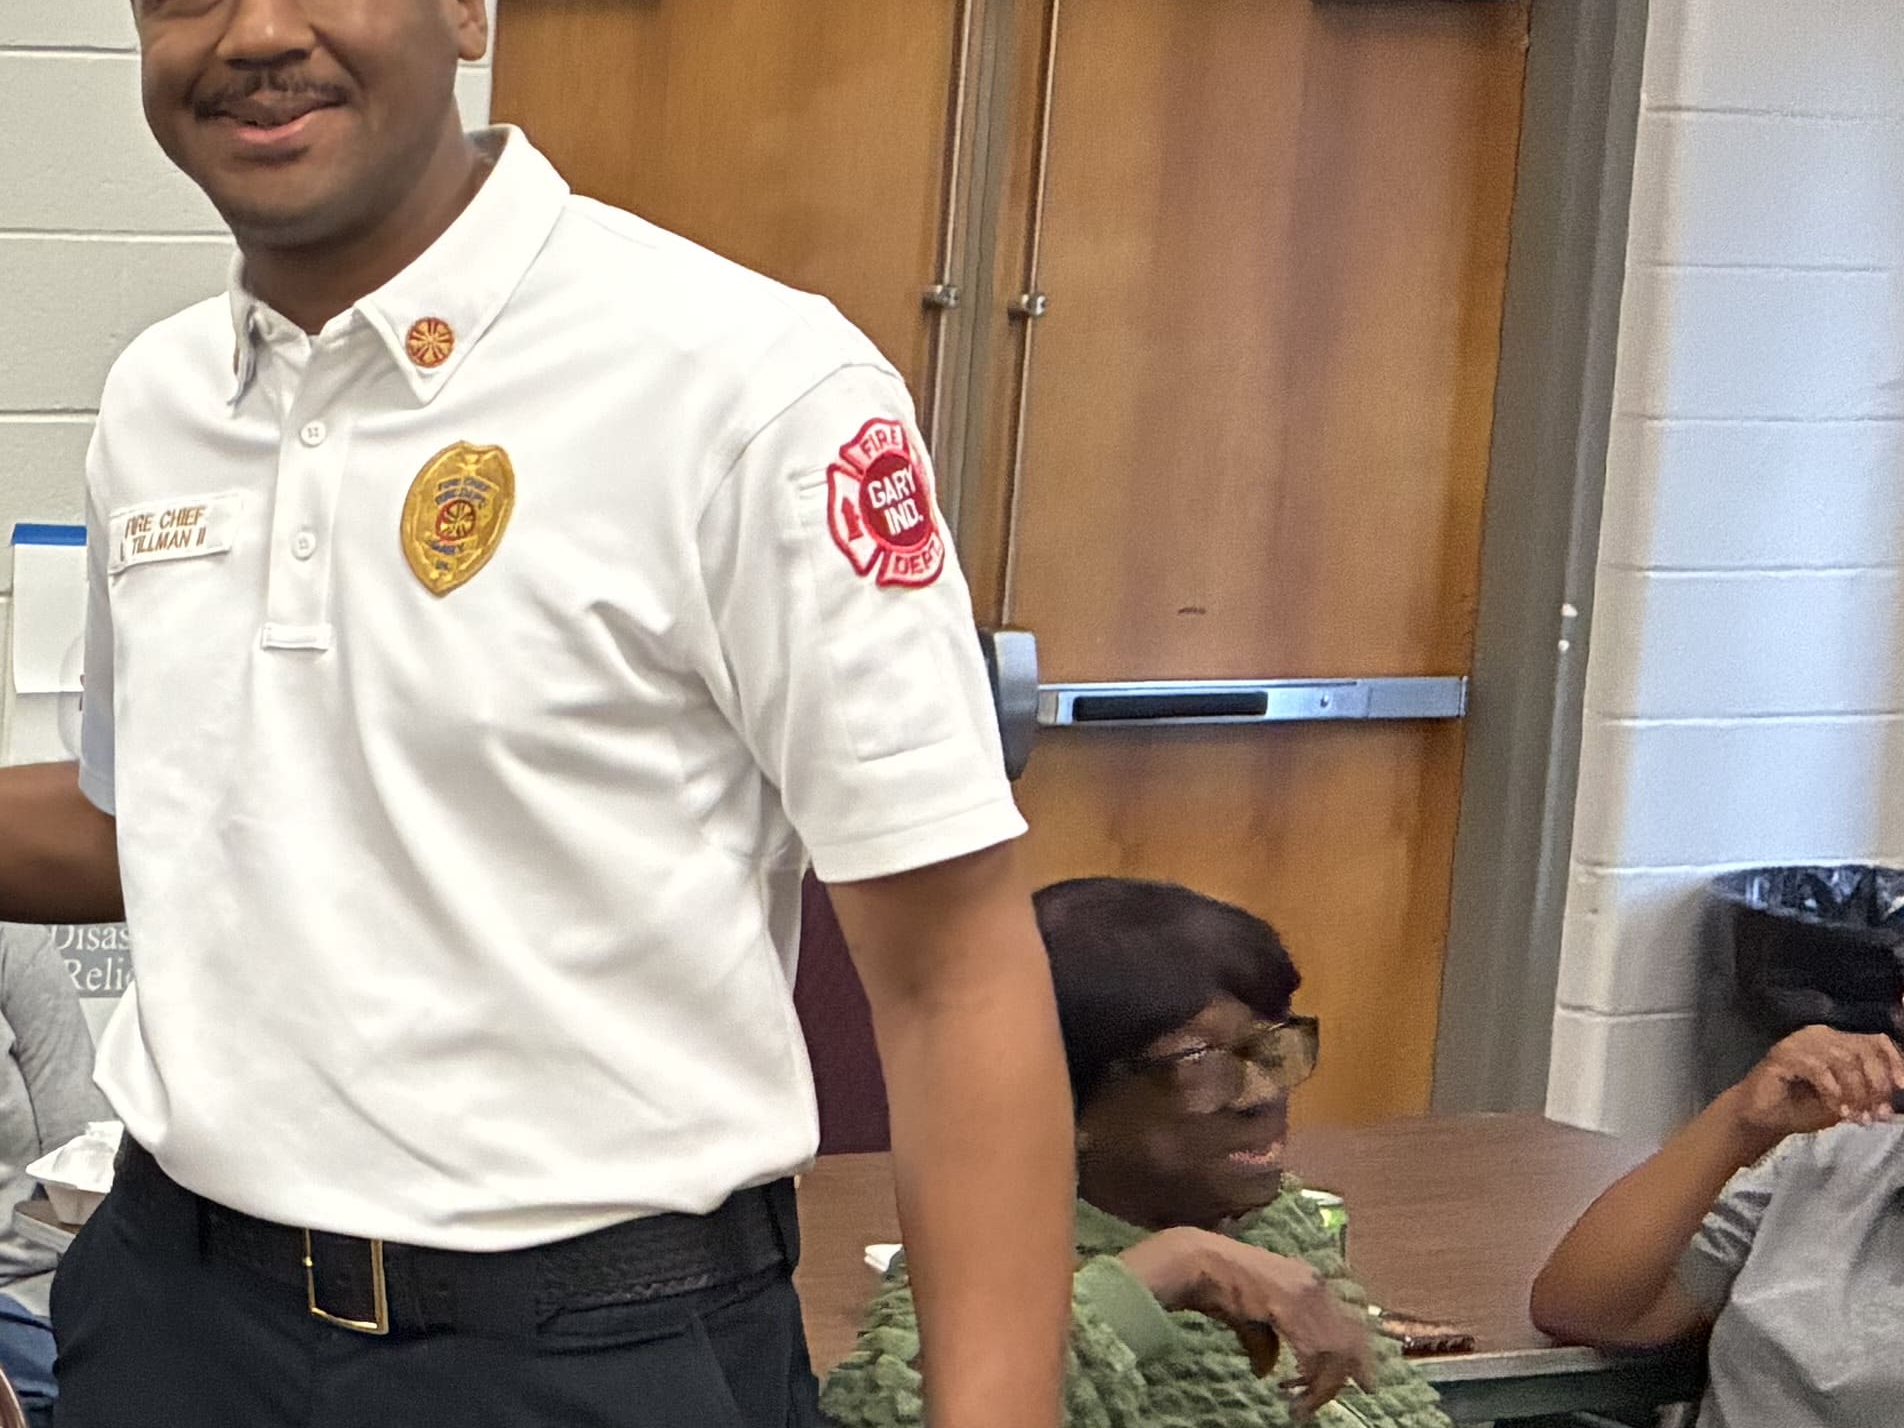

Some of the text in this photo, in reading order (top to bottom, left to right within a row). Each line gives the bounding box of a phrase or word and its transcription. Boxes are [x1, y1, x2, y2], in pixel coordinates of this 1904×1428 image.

[861, 428, 903, 460] FIRE
[867, 464, 917, 509] GARY
[159, 504, 207, 529] CHIEF
[884, 498, 924, 536] IND.
[132, 528, 192, 556] TILLMAN
[63, 956, 132, 992] Reli
